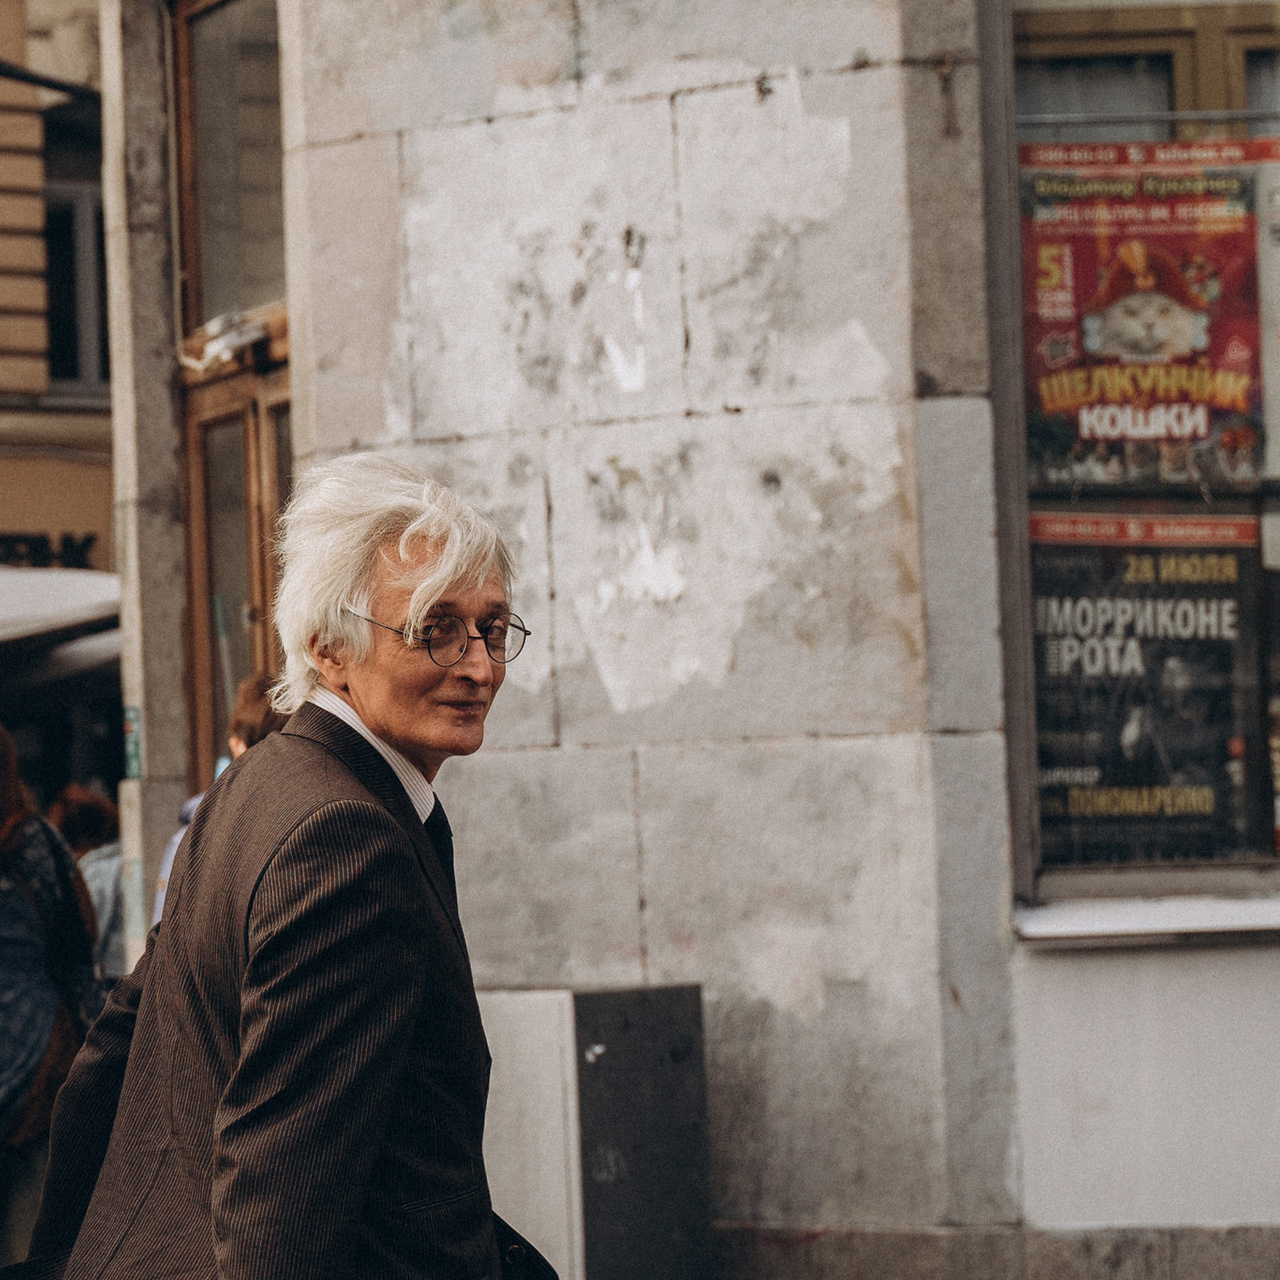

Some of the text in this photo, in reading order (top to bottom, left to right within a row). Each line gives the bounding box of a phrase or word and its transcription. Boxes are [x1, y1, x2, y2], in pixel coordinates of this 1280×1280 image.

[1036, 243, 1063, 289] 5
[1079, 404, 1208, 439] КОШКИ
[1047, 596, 1239, 641] МОРРИКОНЕ
[1060, 637, 1146, 677] РОТА
